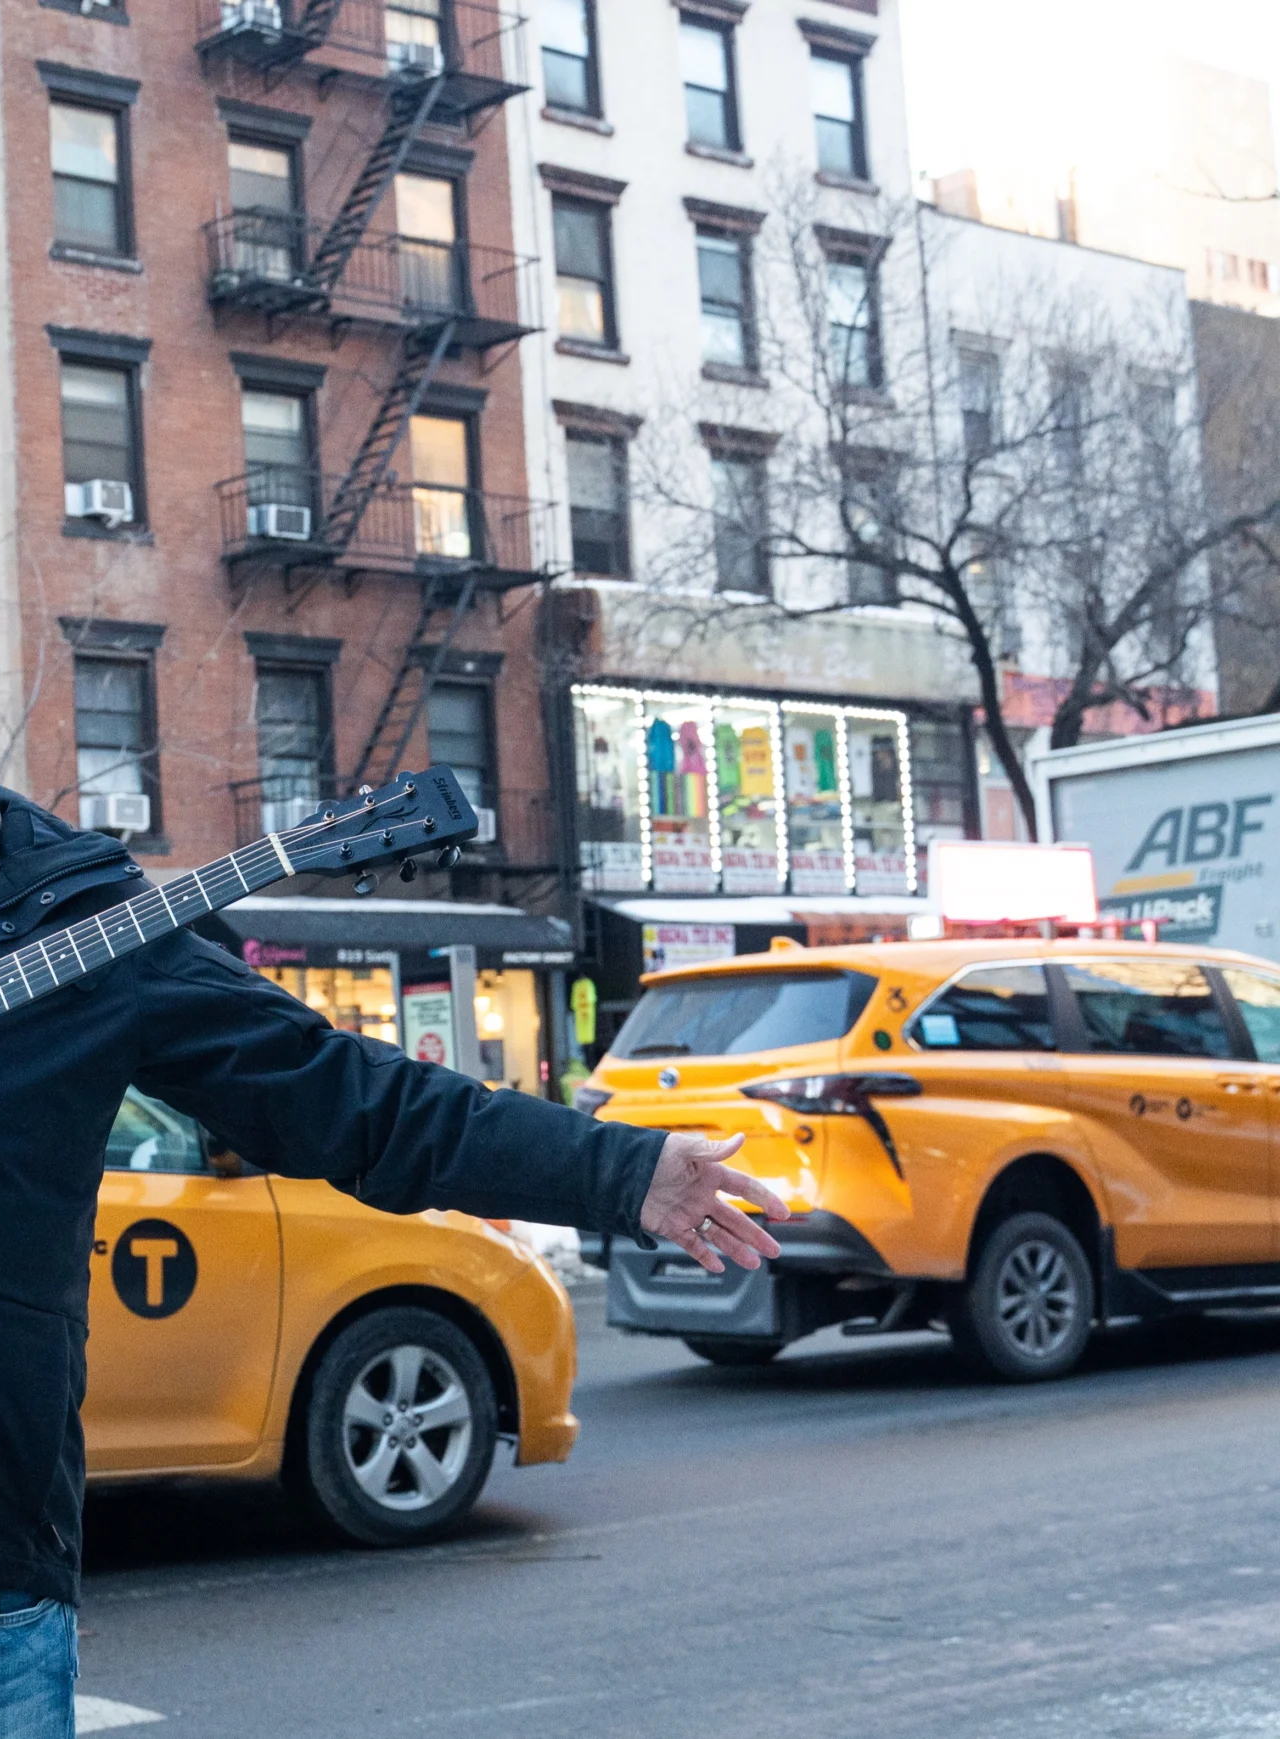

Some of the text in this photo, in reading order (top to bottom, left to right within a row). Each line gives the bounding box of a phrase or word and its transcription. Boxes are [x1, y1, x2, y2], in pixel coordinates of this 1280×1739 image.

[433, 777, 463, 820] Strinberg
[1124, 794, 1272, 872] ABF
[1200, 862, 1263, 883] Freight
[130, 1239, 178, 1307] T
